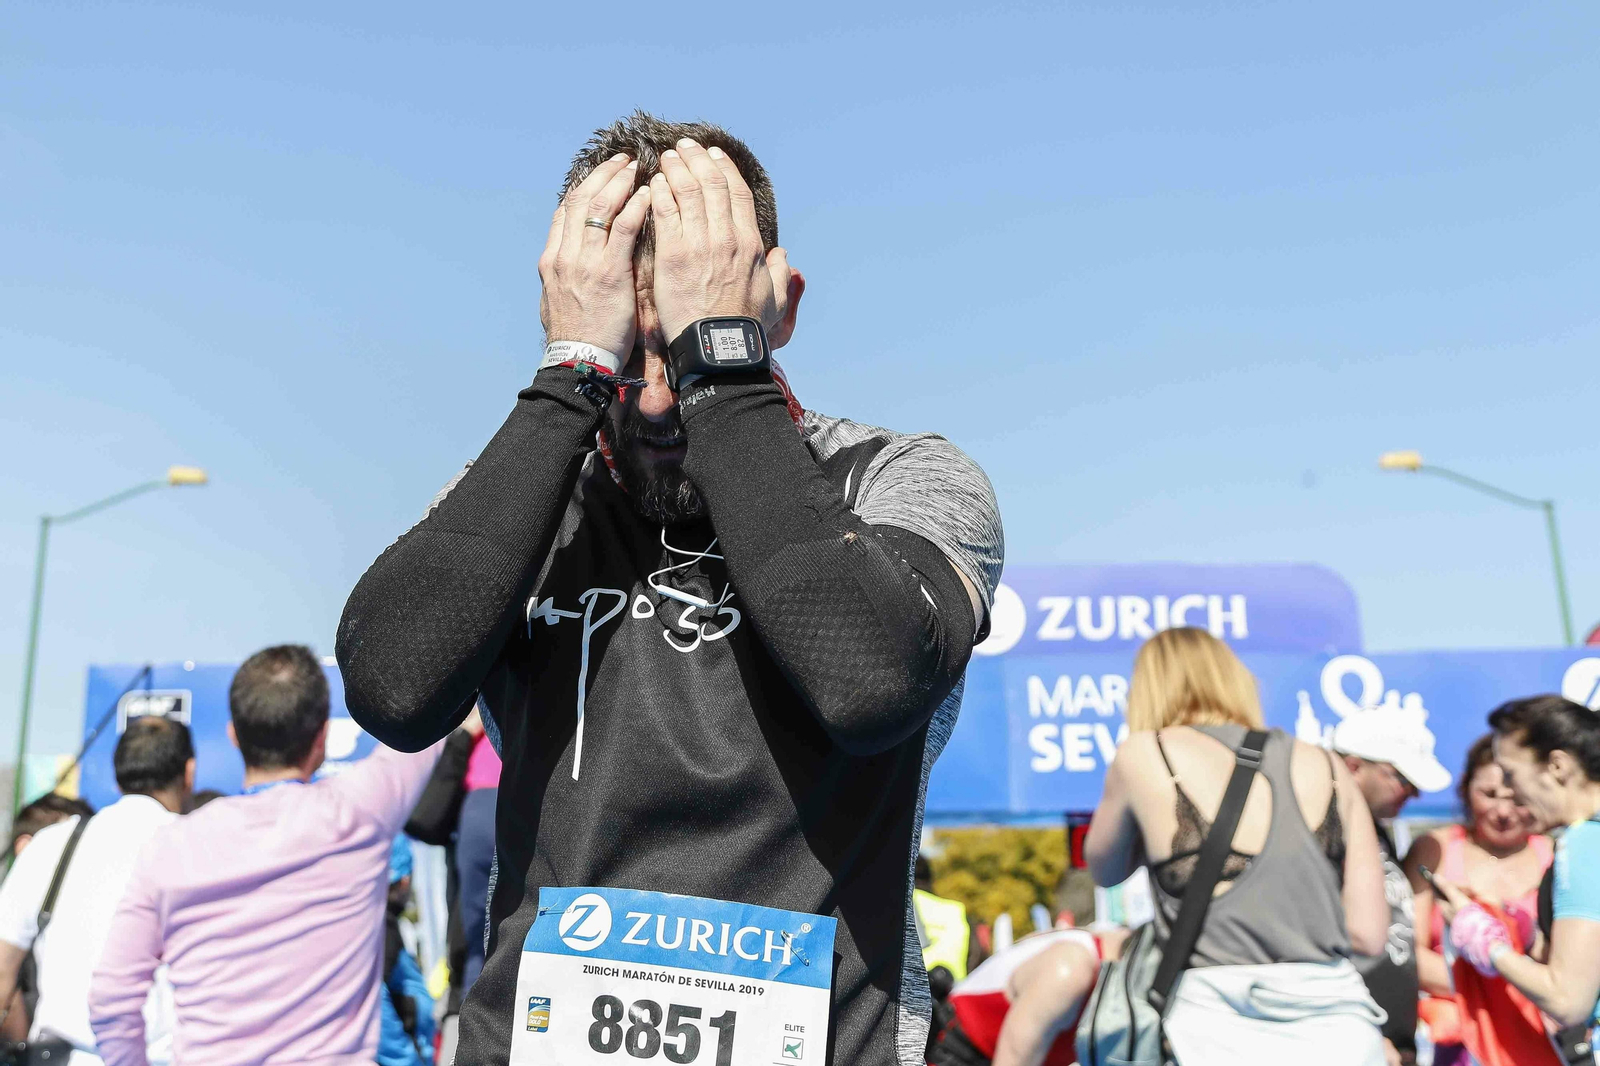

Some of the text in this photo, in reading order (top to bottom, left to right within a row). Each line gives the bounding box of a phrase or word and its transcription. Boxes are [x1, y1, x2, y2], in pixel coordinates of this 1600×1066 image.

[1036, 594, 1249, 641] ZURICH
[620, 912, 795, 966] ZURICH
[583, 964, 765, 996] ZURICH MARATÓN DE SEVILLA 2019
[588, 994, 737, 1066] 8851
[784, 1024, 805, 1033] ELITE
